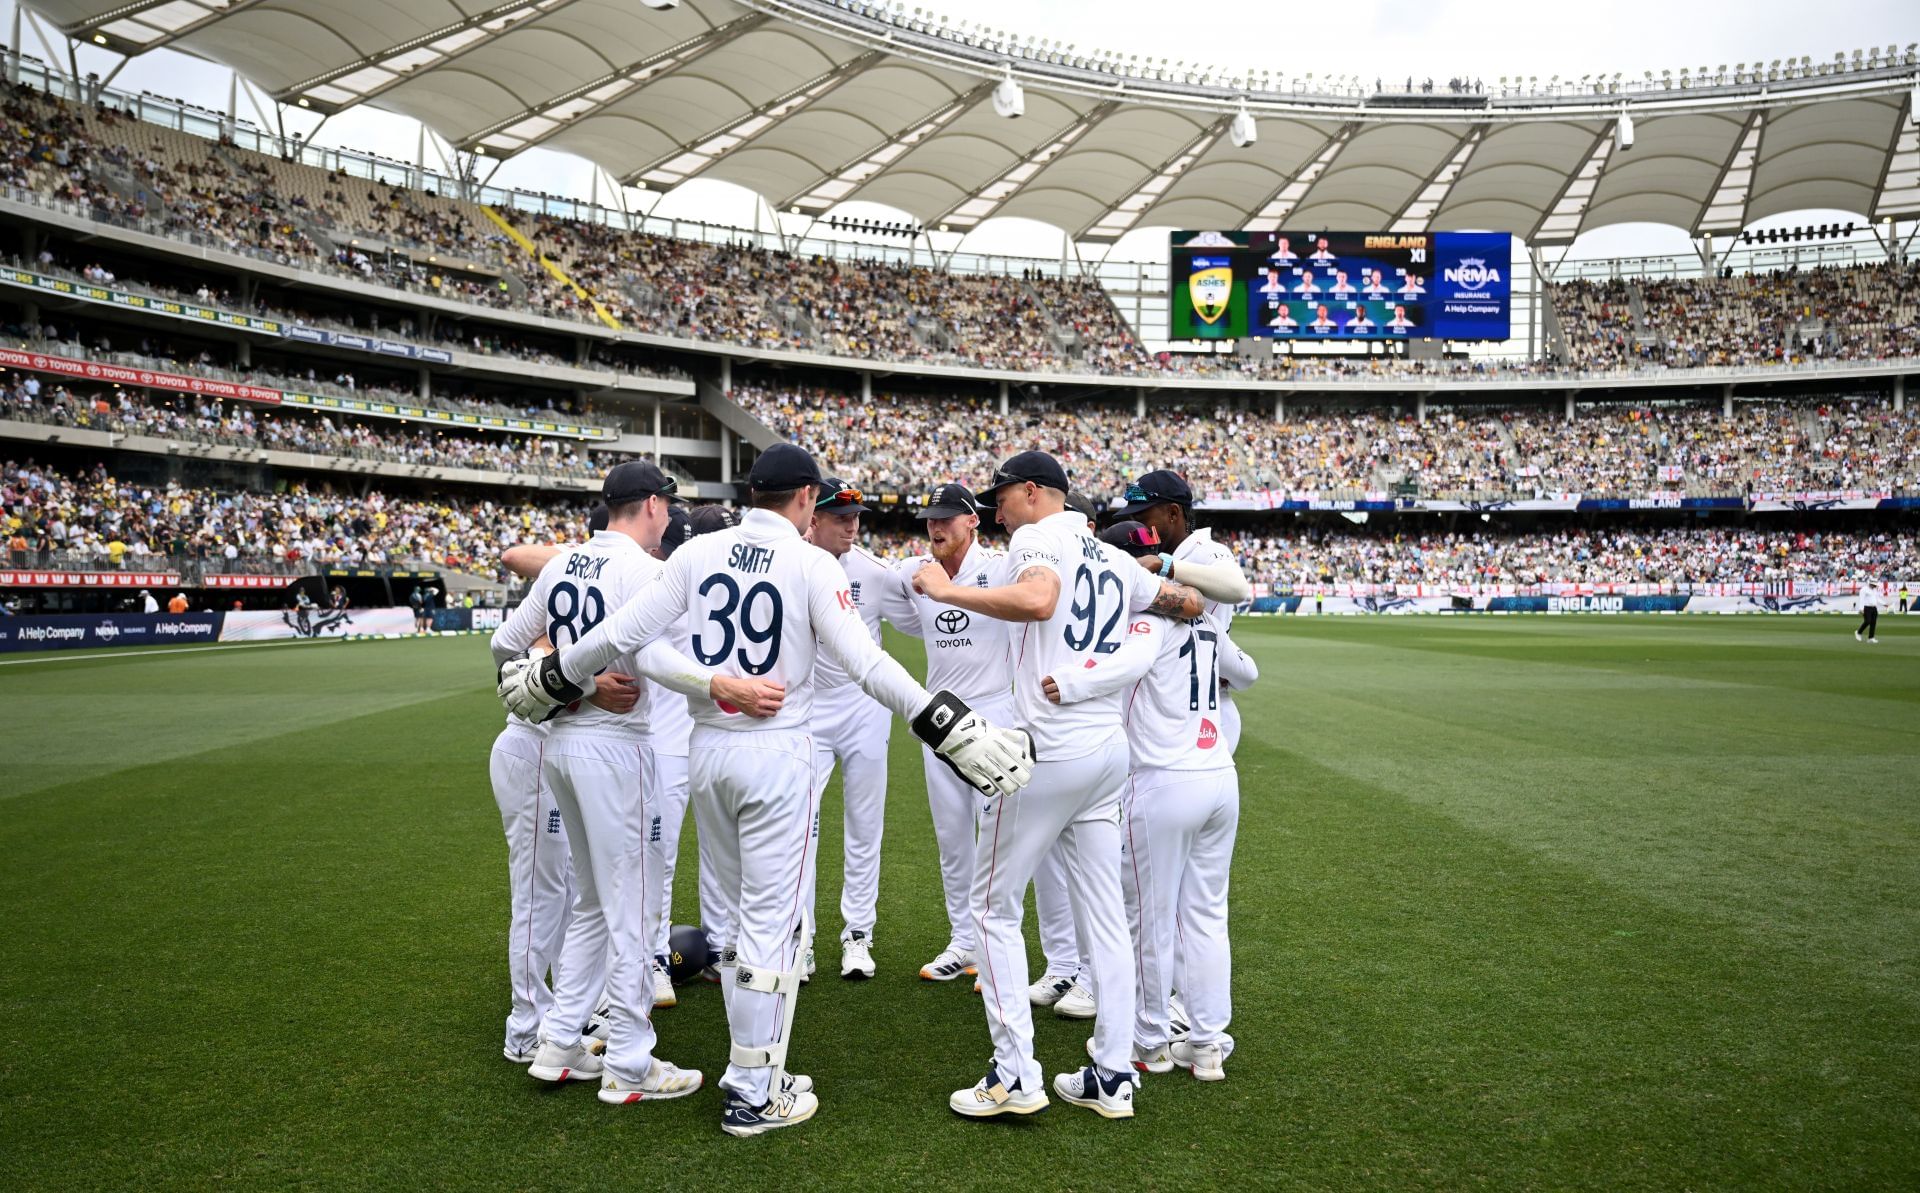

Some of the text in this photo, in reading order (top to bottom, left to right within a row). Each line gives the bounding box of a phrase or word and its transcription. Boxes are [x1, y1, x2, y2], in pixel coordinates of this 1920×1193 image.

[1365, 236, 1426, 248] ENGLAND
[1410, 249, 1426, 263] XI
[1444, 268, 1500, 282] NRMA
[0, 269, 278, 332] bet365 bet365 bet365 bet365 bet365 bet365 bet365 bet365
[1451, 305, 1466, 314] Help
[1468, 306, 1500, 314] Company
[50, 360, 83, 373] TOYOTA
[102, 367, 137, 380] TOYOTA
[155, 376, 188, 388] TOYOTA
[205, 383, 235, 394] TOYOTA
[251, 390, 280, 400] TOYOTA
[1309, 501, 1356, 510] ENGLAND
[1629, 500, 1681, 508] ENGLAND
[1064, 563, 1123, 654] 92
[1548, 597, 1623, 611] ENGLAND
[156, 622, 212, 636] A Help Company
[692, 573, 783, 676] 39
[1129, 622, 1151, 634] IG
[18, 627, 26, 640] A
[26, 626, 45, 642] Help
[46, 626, 85, 640] Company
[936, 638, 972, 648] TOYOTA
[1179, 630, 1217, 711] 17
